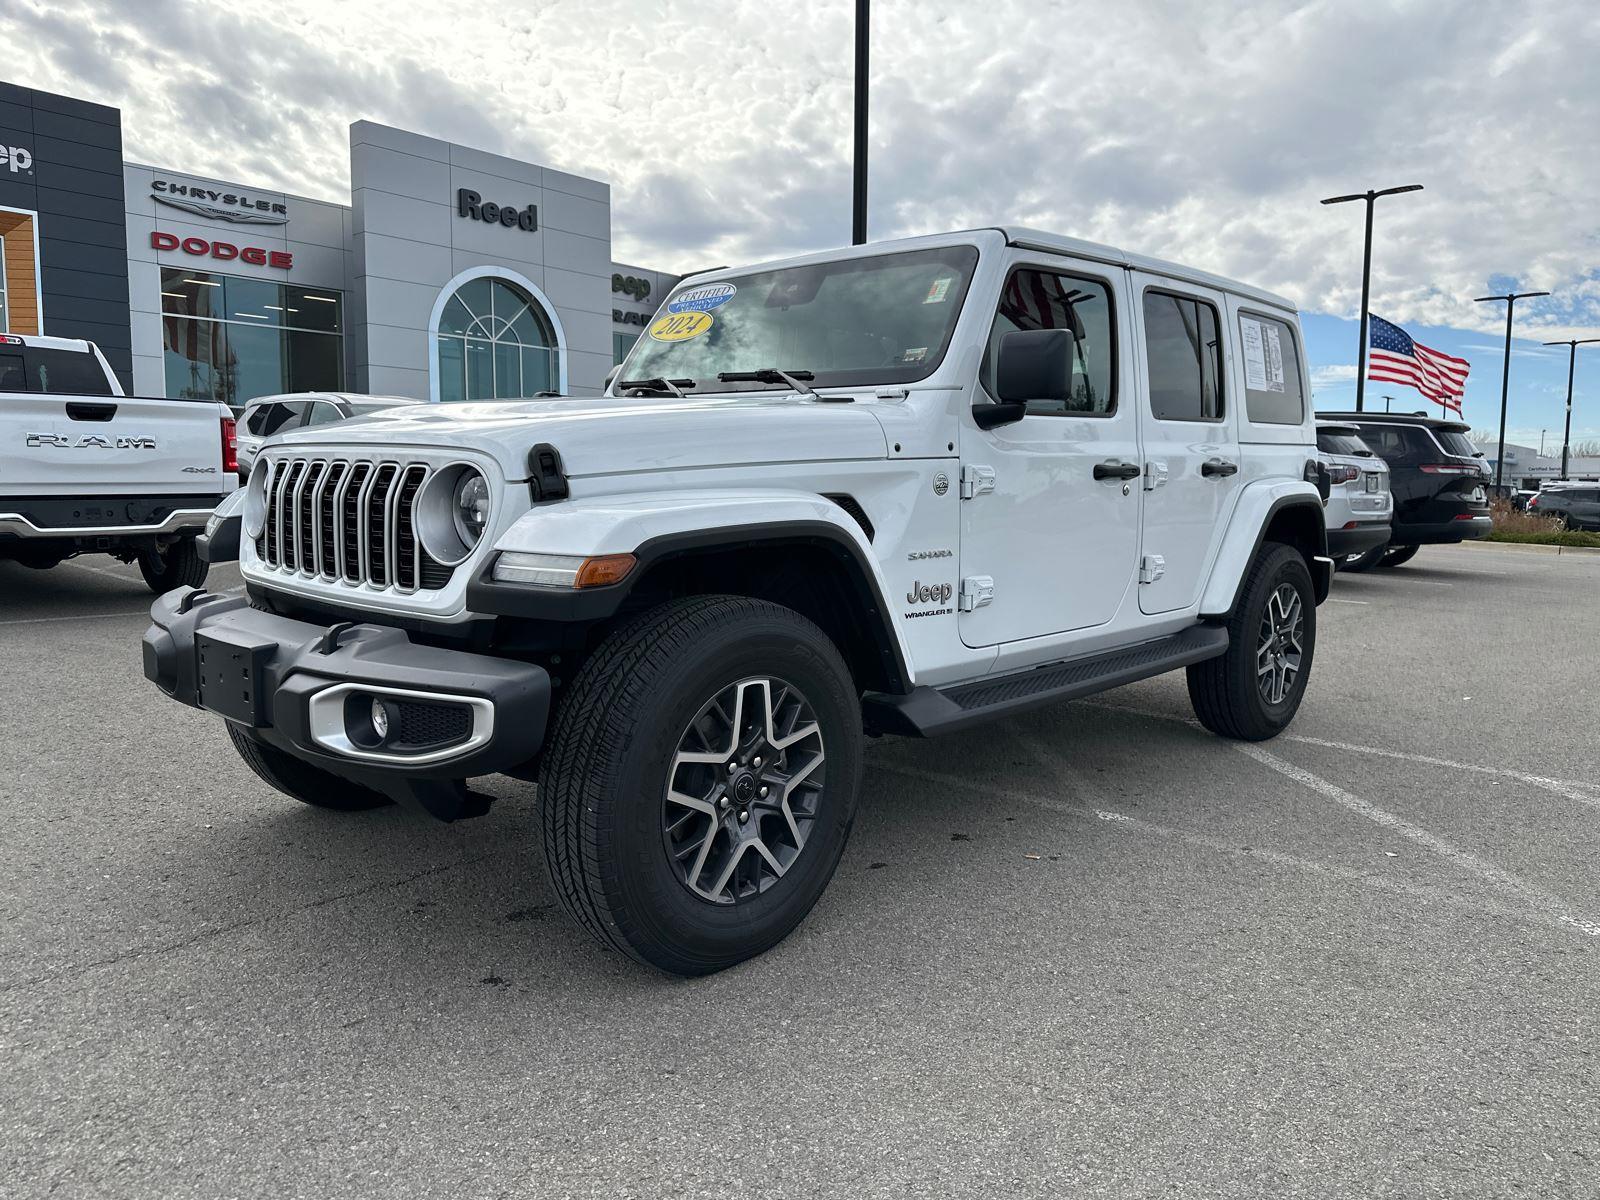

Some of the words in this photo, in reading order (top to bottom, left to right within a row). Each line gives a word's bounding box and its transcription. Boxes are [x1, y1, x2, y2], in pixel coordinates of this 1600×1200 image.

[151, 180, 287, 214] CHRYSLER
[457, 188, 538, 232] Reed
[150, 231, 293, 270] DODGE
[679, 286, 731, 303] CERTIFIED
[655, 315, 706, 335] 2024
[26, 432, 156, 449] RAM
[181, 466, 217, 474] 4x4
[907, 549, 953, 561] SAHARA
[906, 579, 953, 605] Jeep
[904, 608, 946, 620] WRANGLER
